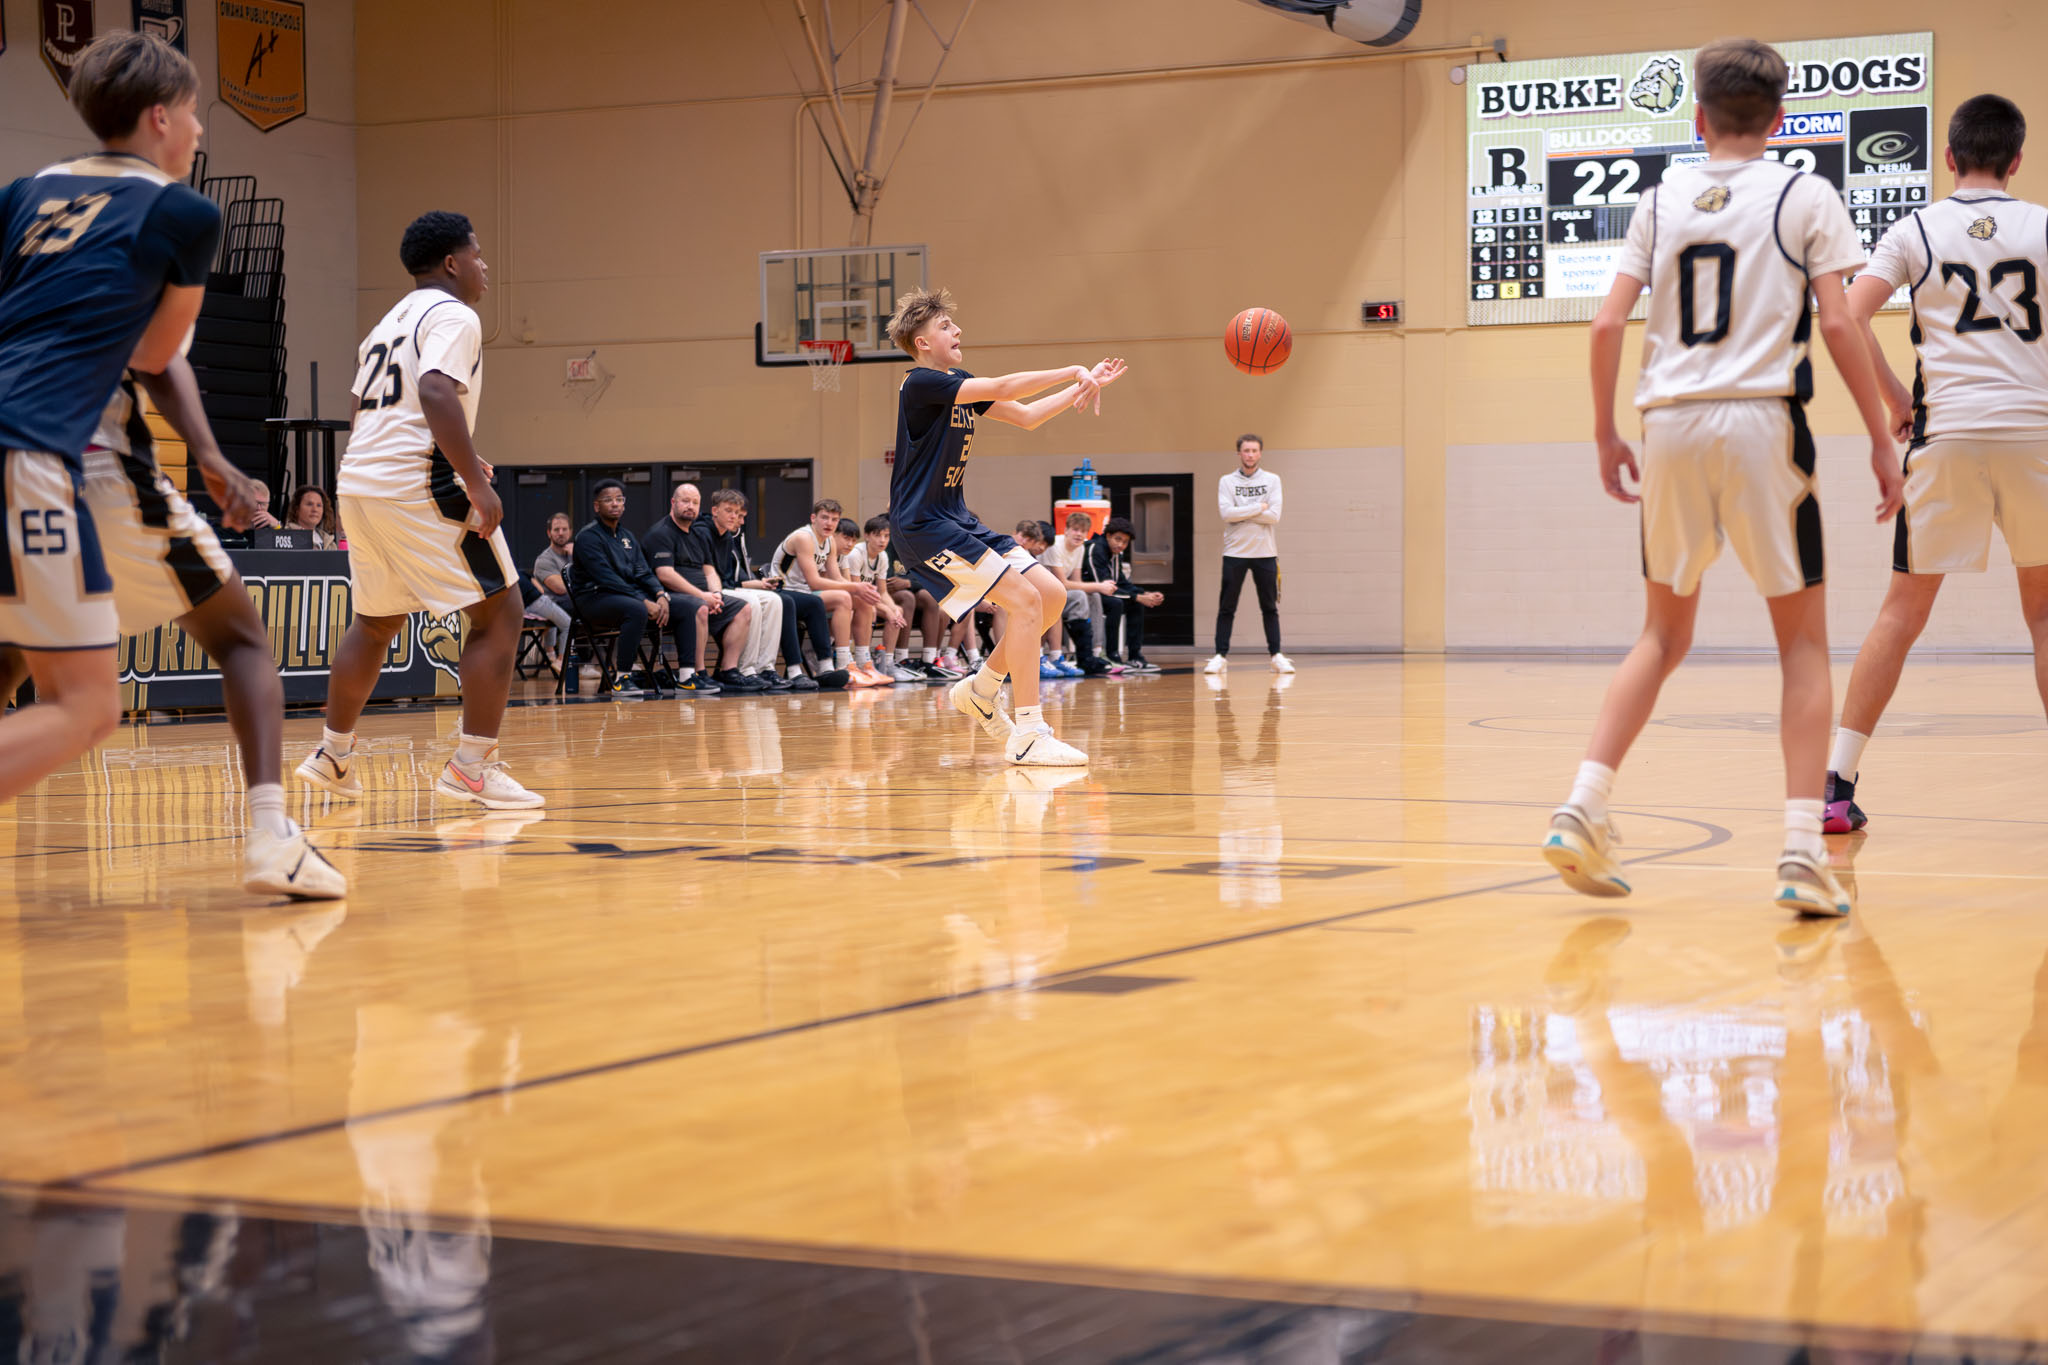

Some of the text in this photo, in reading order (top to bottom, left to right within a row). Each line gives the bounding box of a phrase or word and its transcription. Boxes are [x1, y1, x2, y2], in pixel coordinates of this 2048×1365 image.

[1481, 78, 1617, 114] BURKE
[1549, 127, 1653, 148] BULLDOGS
[1878, 163, 1912, 173] PERJU
[1573, 158, 1641, 206] 22
[1852, 188, 1921, 205] 35 7 0
[1476, 210, 1495, 224] 12
[1528, 208, 1538, 220] 1
[1552, 210, 1593, 221] FOULS
[1855, 208, 1872, 224] 11
[1886, 209, 1897, 221] 6
[1474, 226, 1538, 243] 23 4 1
[1564, 222, 1580, 243] 1
[1479, 245, 1538, 261] 4 3 4
[1558, 255, 1602, 265] Become
[1505, 265, 1516, 278] 2
[1528, 265, 1538, 277] 0
[1562, 269, 1606, 279] sponsor
[1476, 284, 1495, 299] 15
[1528, 283, 1538, 295] 1
[1678, 241, 1738, 349] 0
[1939, 256, 2044, 345] 23
[357, 334, 408, 411] 25
[1235, 485, 1268, 497] BURKE
[21, 509, 67, 555] ES
[275, 535, 293, 548] POSS.
